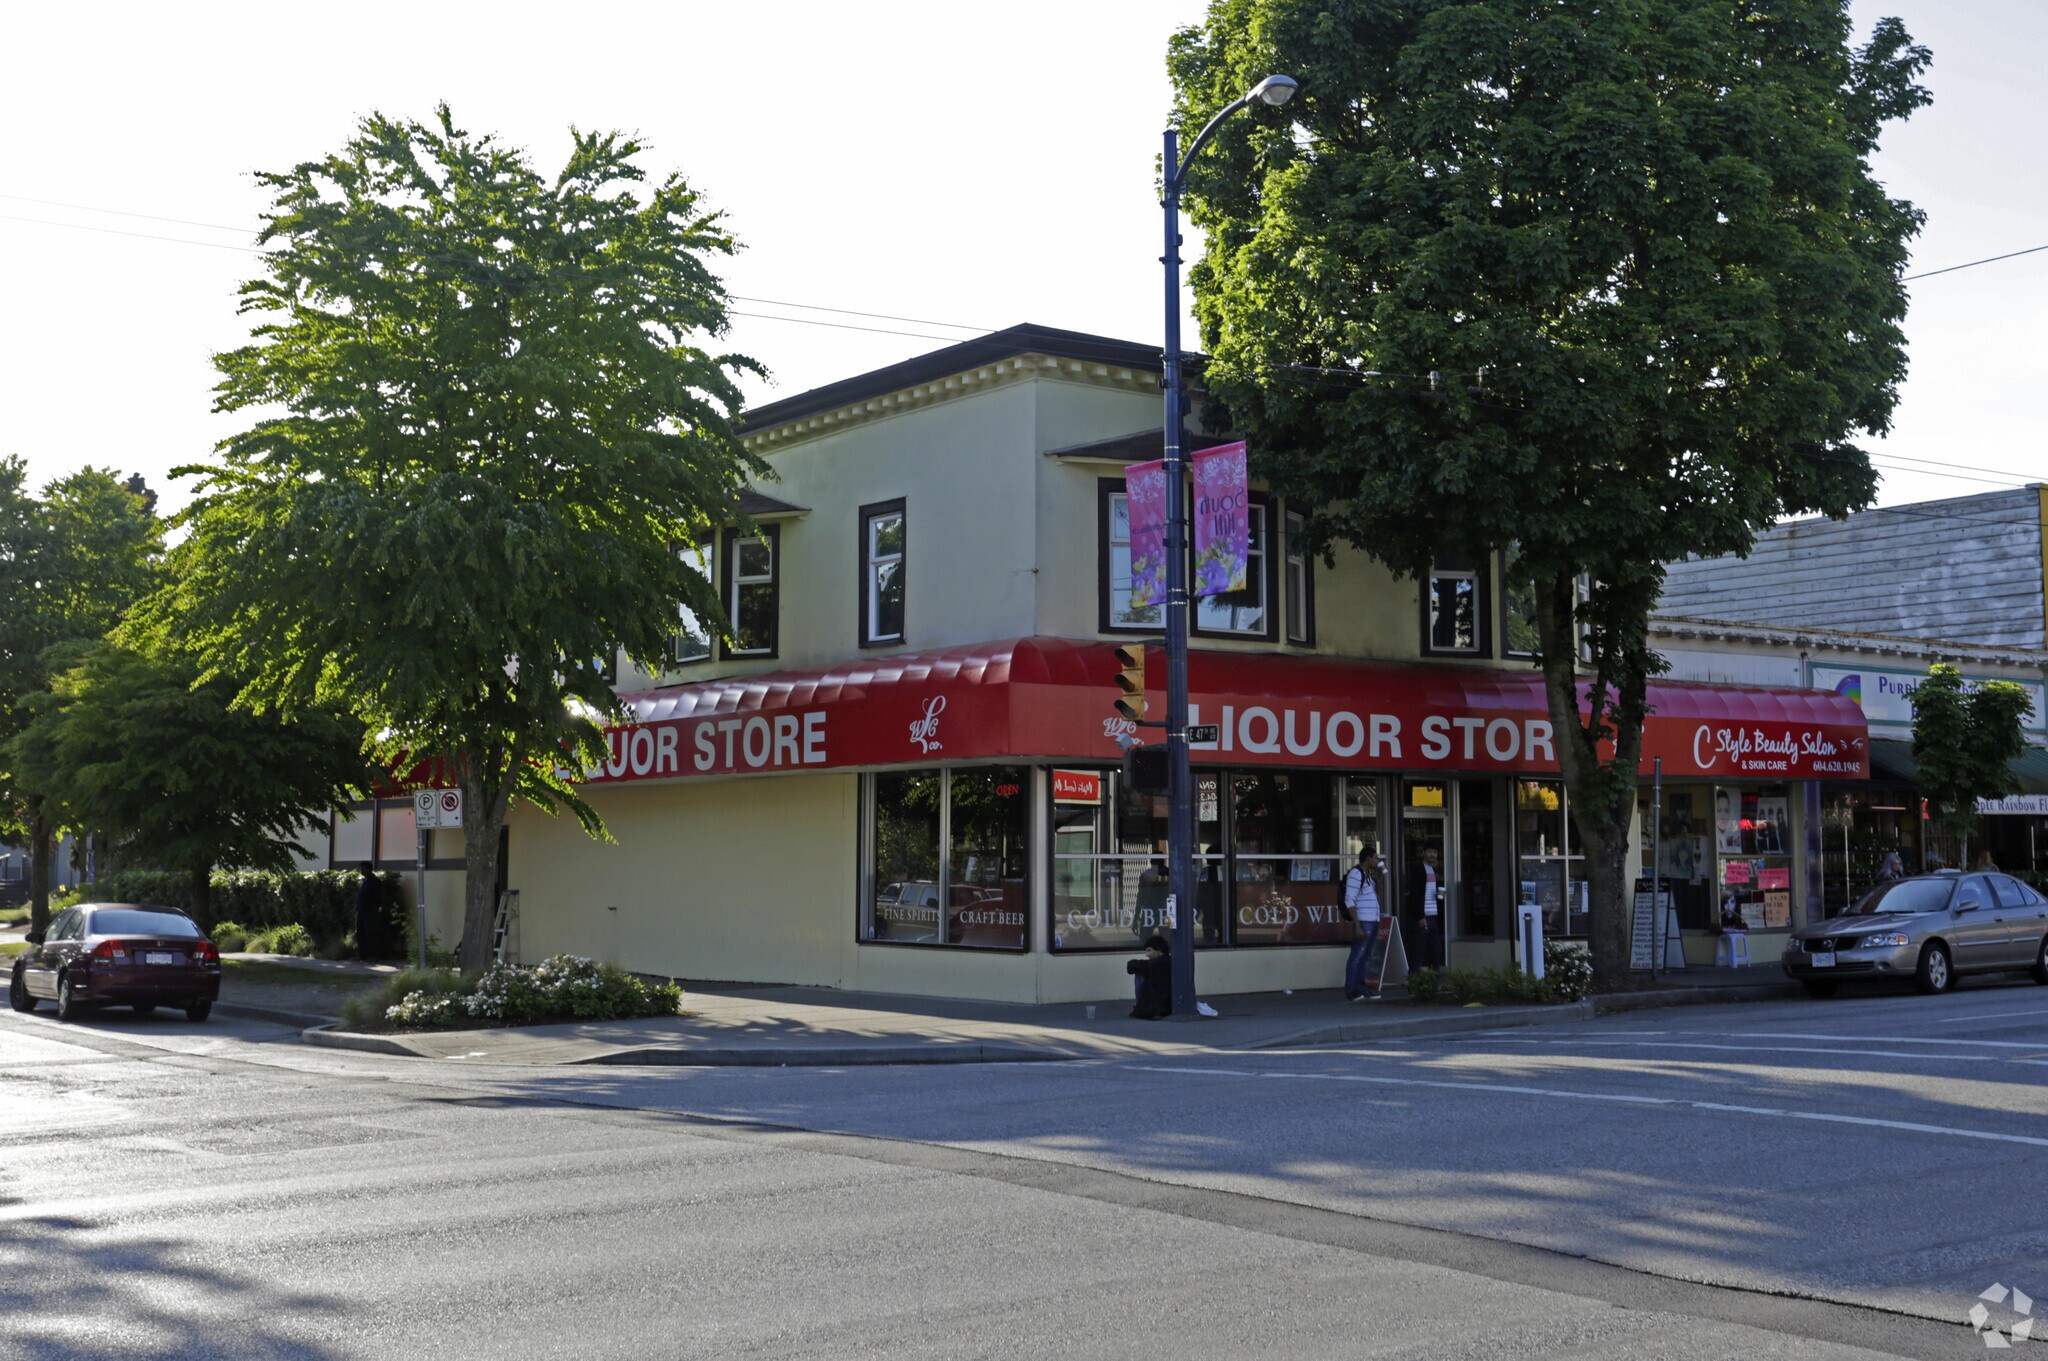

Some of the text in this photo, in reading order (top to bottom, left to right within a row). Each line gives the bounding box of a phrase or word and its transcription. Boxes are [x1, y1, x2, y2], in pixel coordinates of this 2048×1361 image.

[1188, 703, 1402, 758] LIQUOR
[1421, 715, 1556, 761] STOR
[555, 710, 827, 780] LUOR STORE
[1715, 728, 1752, 763] Style
[1753, 728, 1798, 765] Beauty
[1800, 730, 1837, 756] Salon
[1741, 760, 1787, 771] & SKIN CARE
[1812, 760, 1861, 773] 604.620.1945
[996, 784, 1019, 797] OPEN
[884, 908, 940, 922] FINE SPIRITS
[959, 910, 1025, 926] CRAFT BEER
[1067, 908, 1134, 929] COLD
[1239, 905, 1350, 926] COLD WIN
